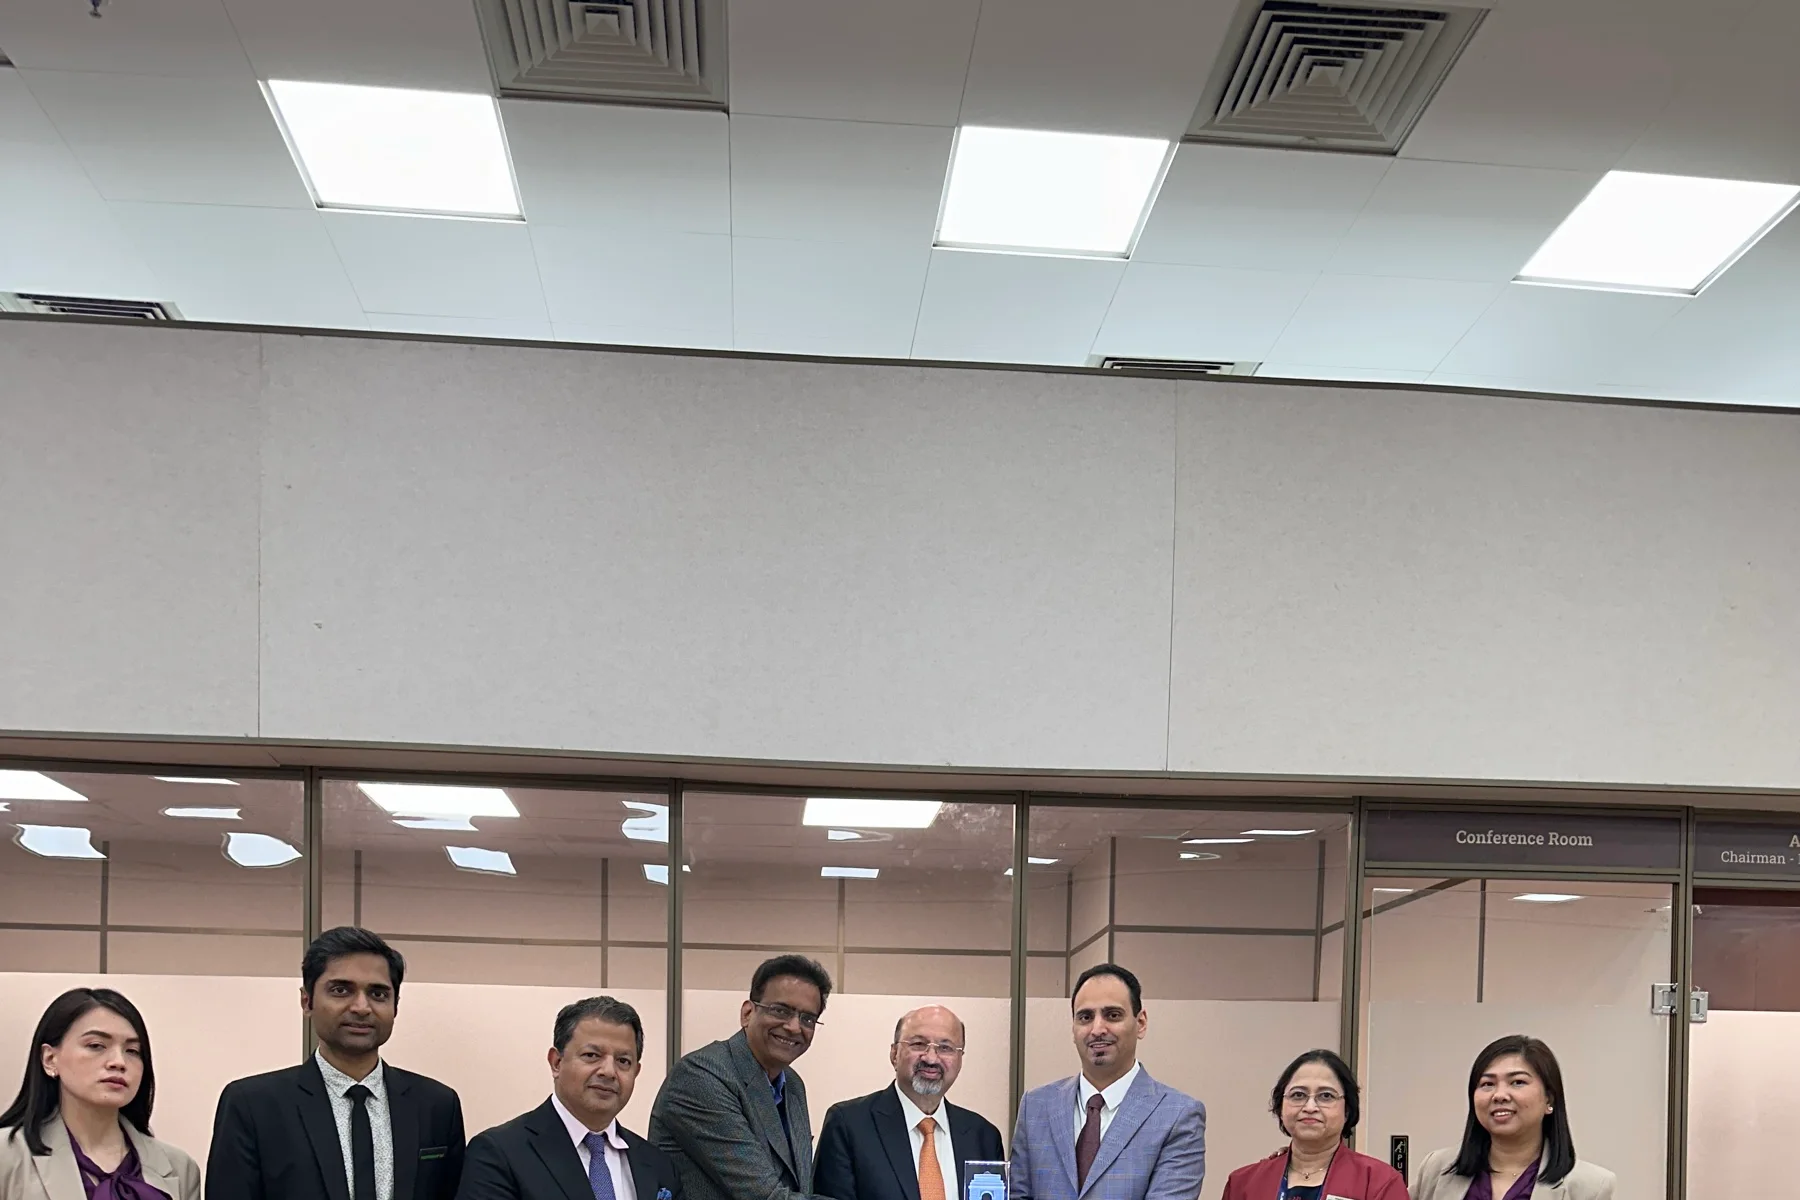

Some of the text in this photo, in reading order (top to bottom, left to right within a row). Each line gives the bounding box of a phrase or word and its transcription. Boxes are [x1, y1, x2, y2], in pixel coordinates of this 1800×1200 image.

[1456, 830, 1593, 846] Conference Room
[1721, 851, 1786, 864] Chairman
